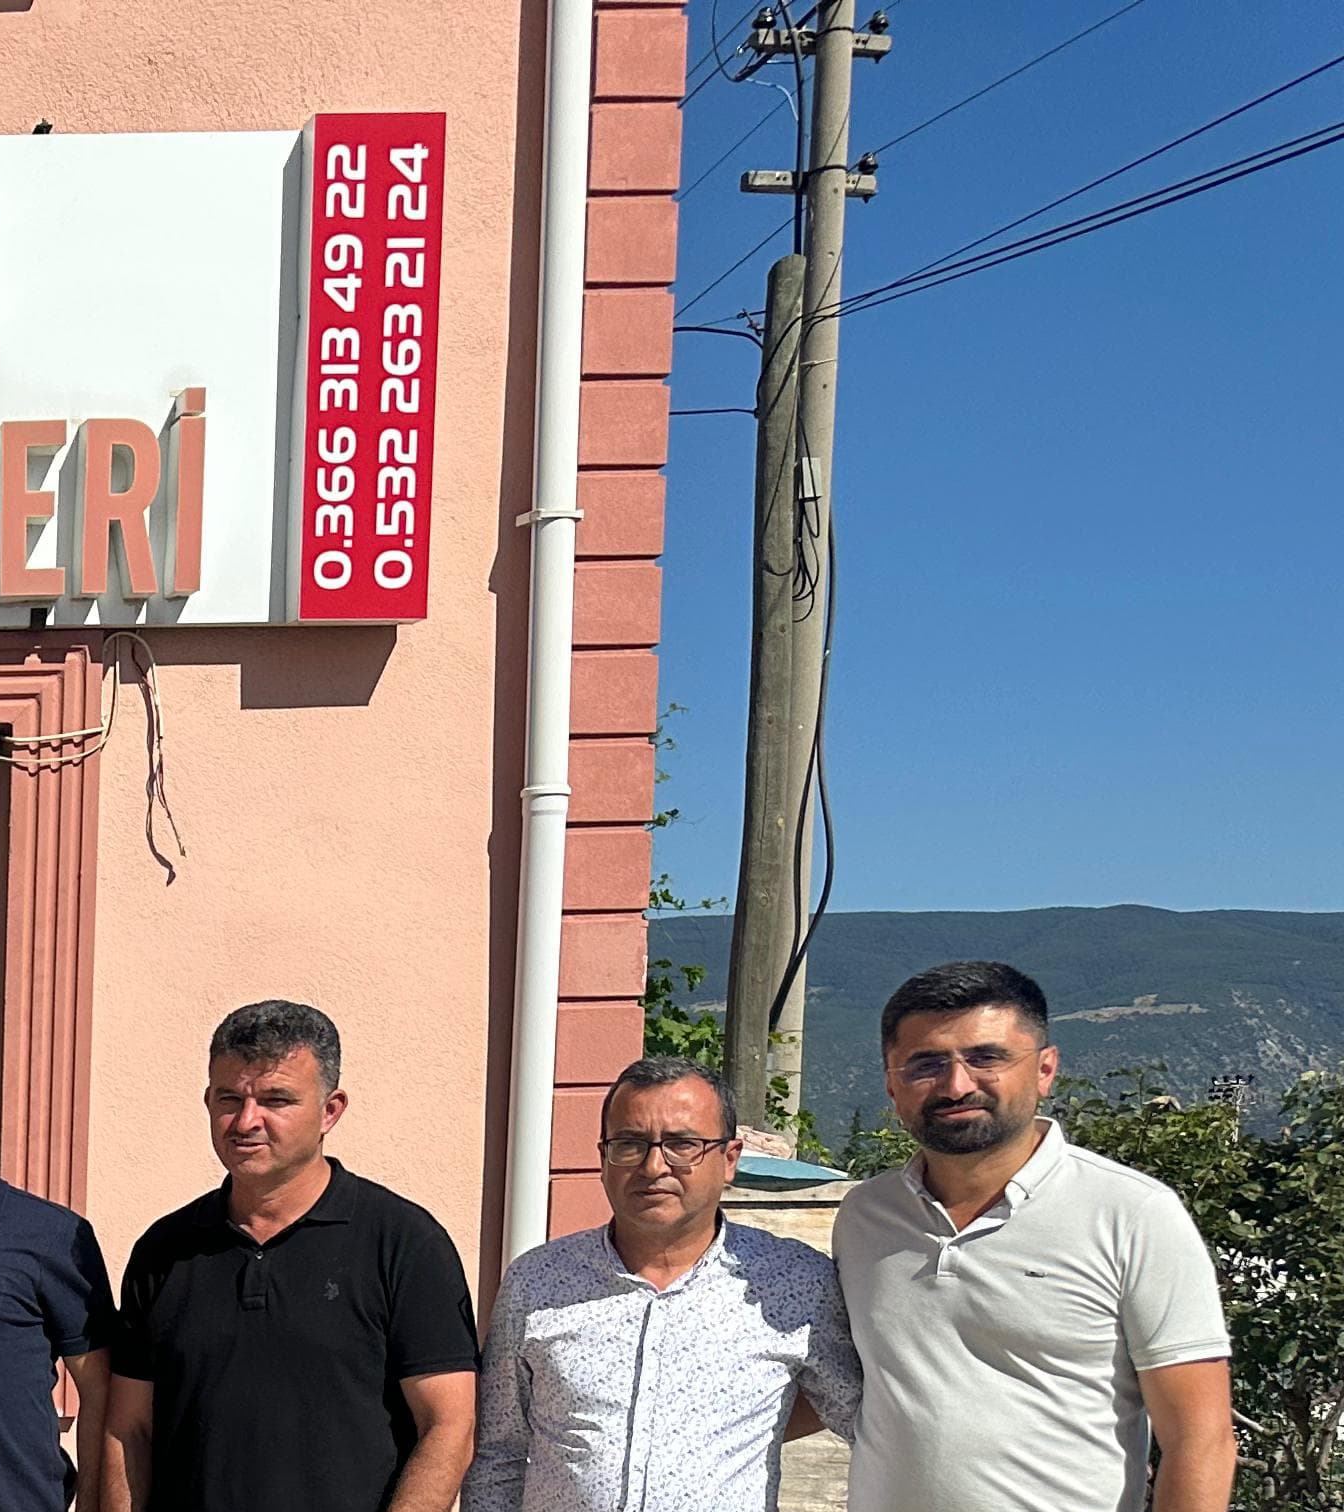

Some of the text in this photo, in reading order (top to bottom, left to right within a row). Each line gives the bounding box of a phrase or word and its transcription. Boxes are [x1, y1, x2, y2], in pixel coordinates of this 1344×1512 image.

[313, 143, 367, 590] 0.366 313 49 22
[373, 143, 429, 589] 0.532 263 21 24
